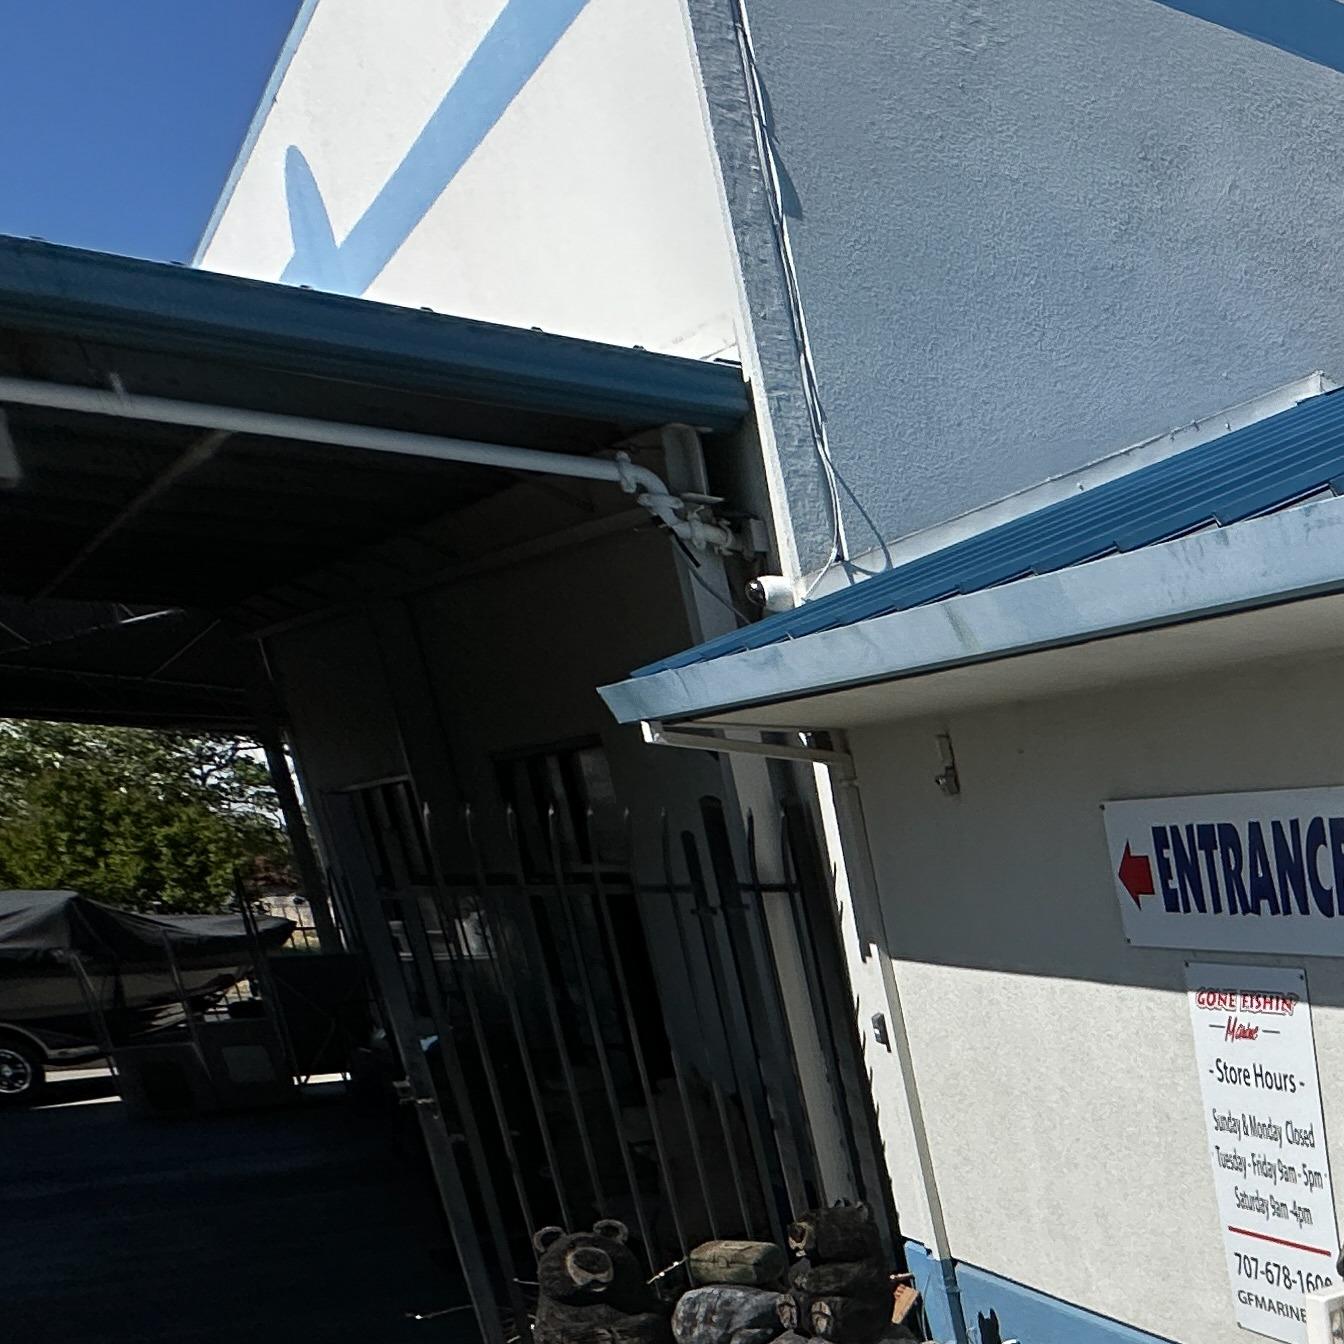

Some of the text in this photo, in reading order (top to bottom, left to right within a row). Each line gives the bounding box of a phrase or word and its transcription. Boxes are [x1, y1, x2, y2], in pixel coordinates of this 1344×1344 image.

[1196, 986, 1238, 1012] GONE
[1215, 1057, 1251, 1087] Store
[1252, 1062, 1297, 1094] Hours
[1212, 1107, 1242, 1142] Sunday
[1248, 1114, 1283, 1149] Monday
[1284, 1119, 1316, 1149] Closed
[1214, 1145, 1247, 1179] Tuesday
[1250, 1152, 1277, 1187] Friday
[1301, 1163, 1324, 1193] 5pm
[1233, 1185, 1270, 1222] Saturday
